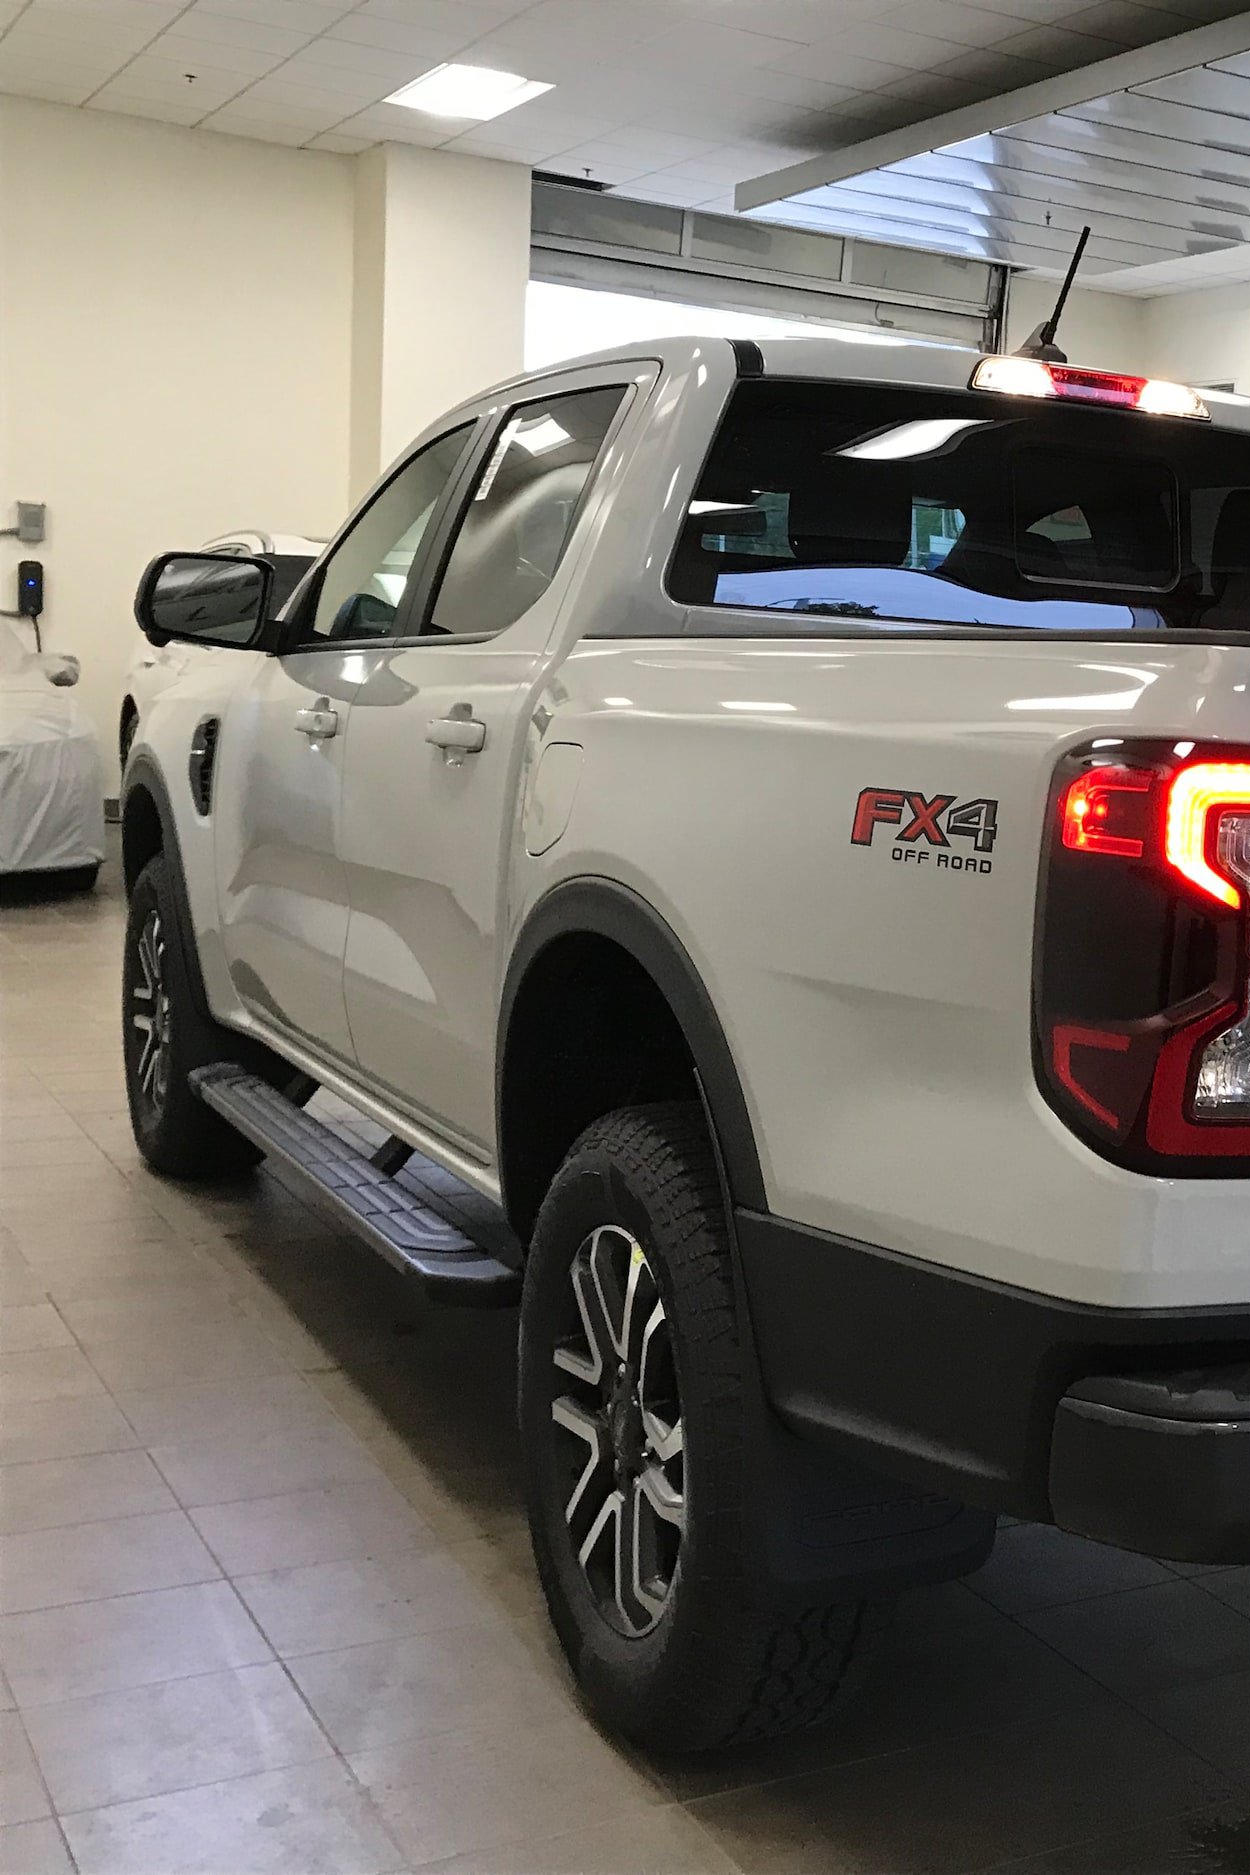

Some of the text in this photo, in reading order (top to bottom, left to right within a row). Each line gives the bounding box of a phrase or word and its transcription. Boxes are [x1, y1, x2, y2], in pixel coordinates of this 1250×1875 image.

[850, 787, 999, 853] FX4
[891, 848, 993, 874] OFF ROAD
